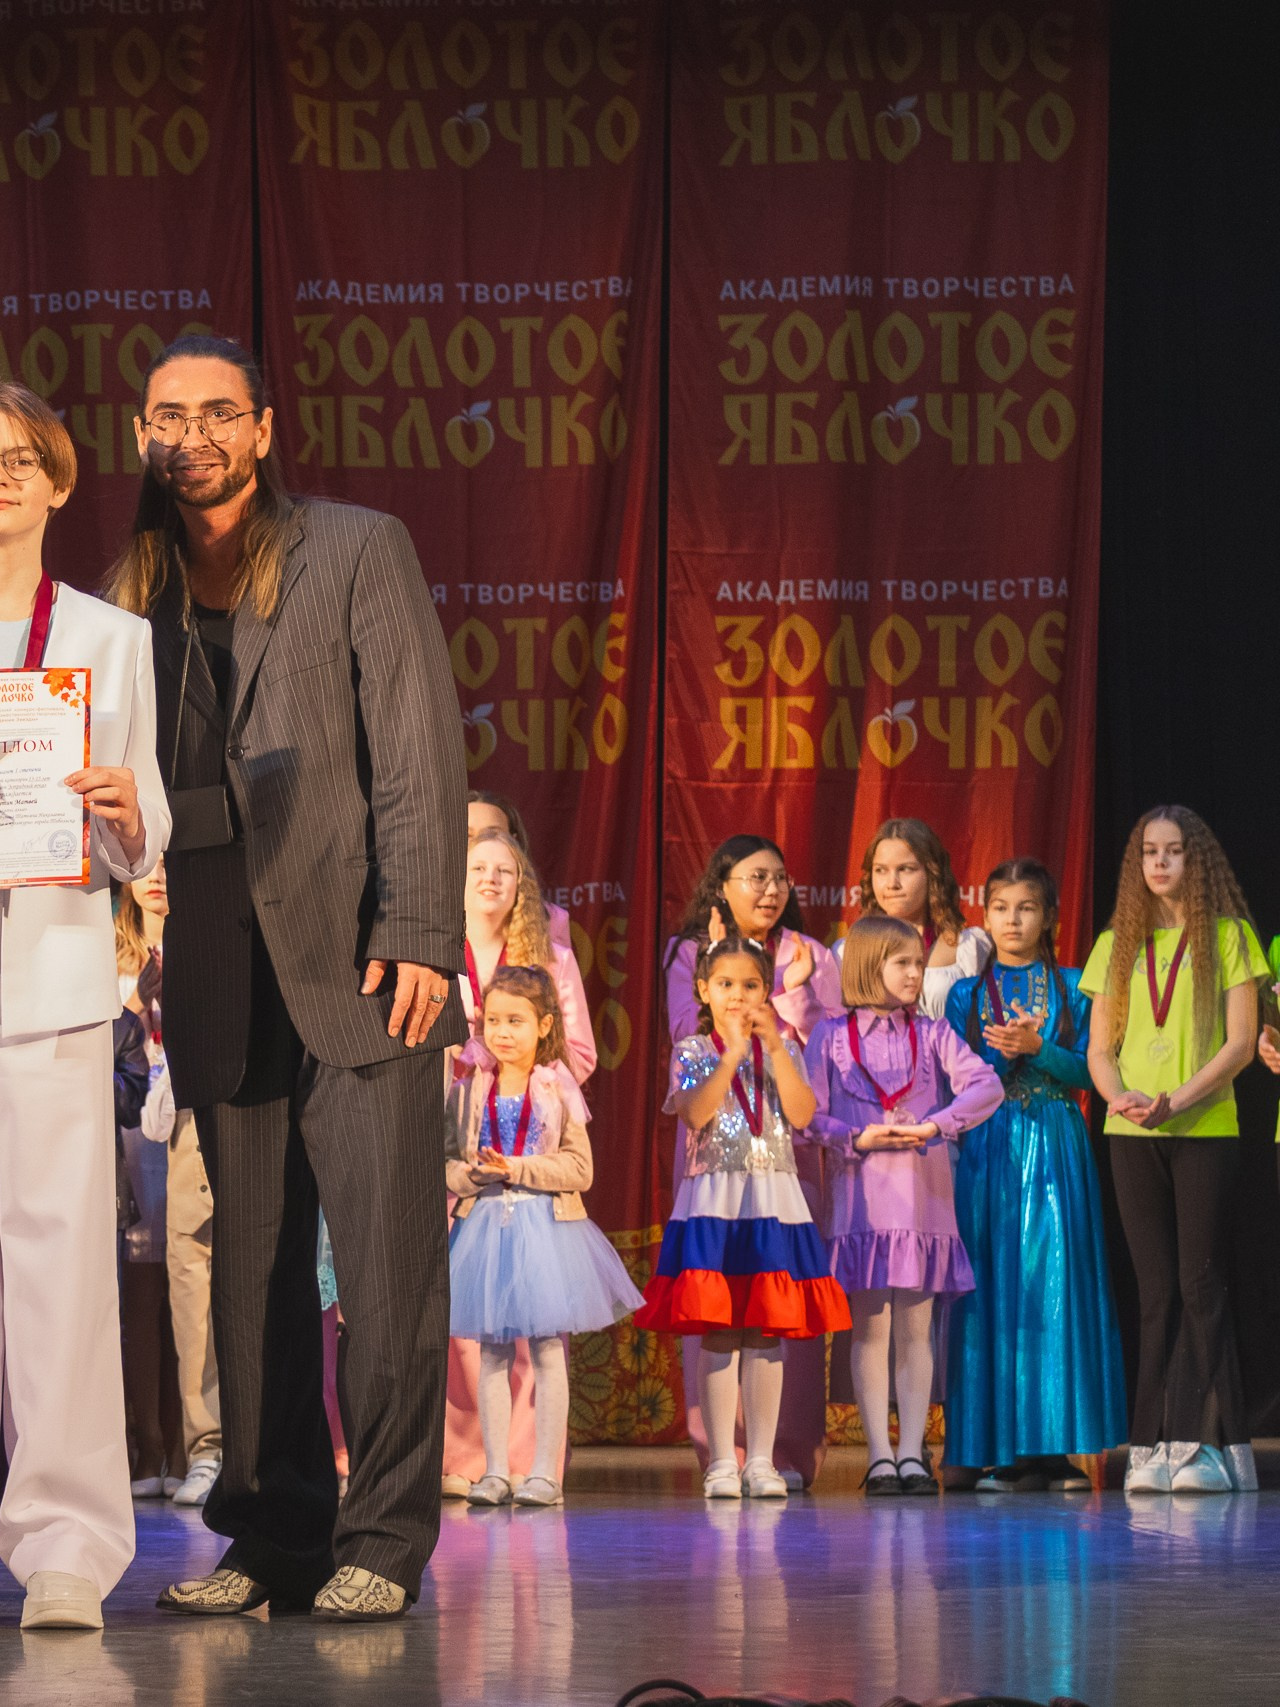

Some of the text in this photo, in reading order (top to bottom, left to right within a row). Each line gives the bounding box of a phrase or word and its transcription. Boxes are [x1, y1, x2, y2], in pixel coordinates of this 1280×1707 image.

[288, 15, 640, 91] ЗОЛОТОЕ
[720, 9, 1074, 87] ЗОЛОТОЕ
[289, 92, 641, 171] ЯБЛОЧКО
[720, 87, 1076, 167] ЯБЛОЧКО
[29, 288, 212, 314] ТВОРЧЕСТВА
[296, 278, 444, 305] АКАДЕМИЯ
[720, 273, 1075, 302] АКАДЕМИЯ ТВОРЧЕСТВА
[718, 307, 1077, 385] ЗОЛОТОЕ
[297, 390, 628, 469] ЯБЛОЧКО
[718, 388, 1077, 465] ЯБЛОЧКО
[458, 577, 625, 605] ТВОРЧЕСТВА
[716, 576, 1069, 605] АКАДЕМИЯ ТВОРЧЕСТВА
[450, 611, 628, 690] ОТОЕ
[714, 610, 1068, 688] ЗОЛОТОЕ
[463, 692, 629, 772] ОЧКО
[712, 691, 1063, 769] ЯБЛОЧКО
